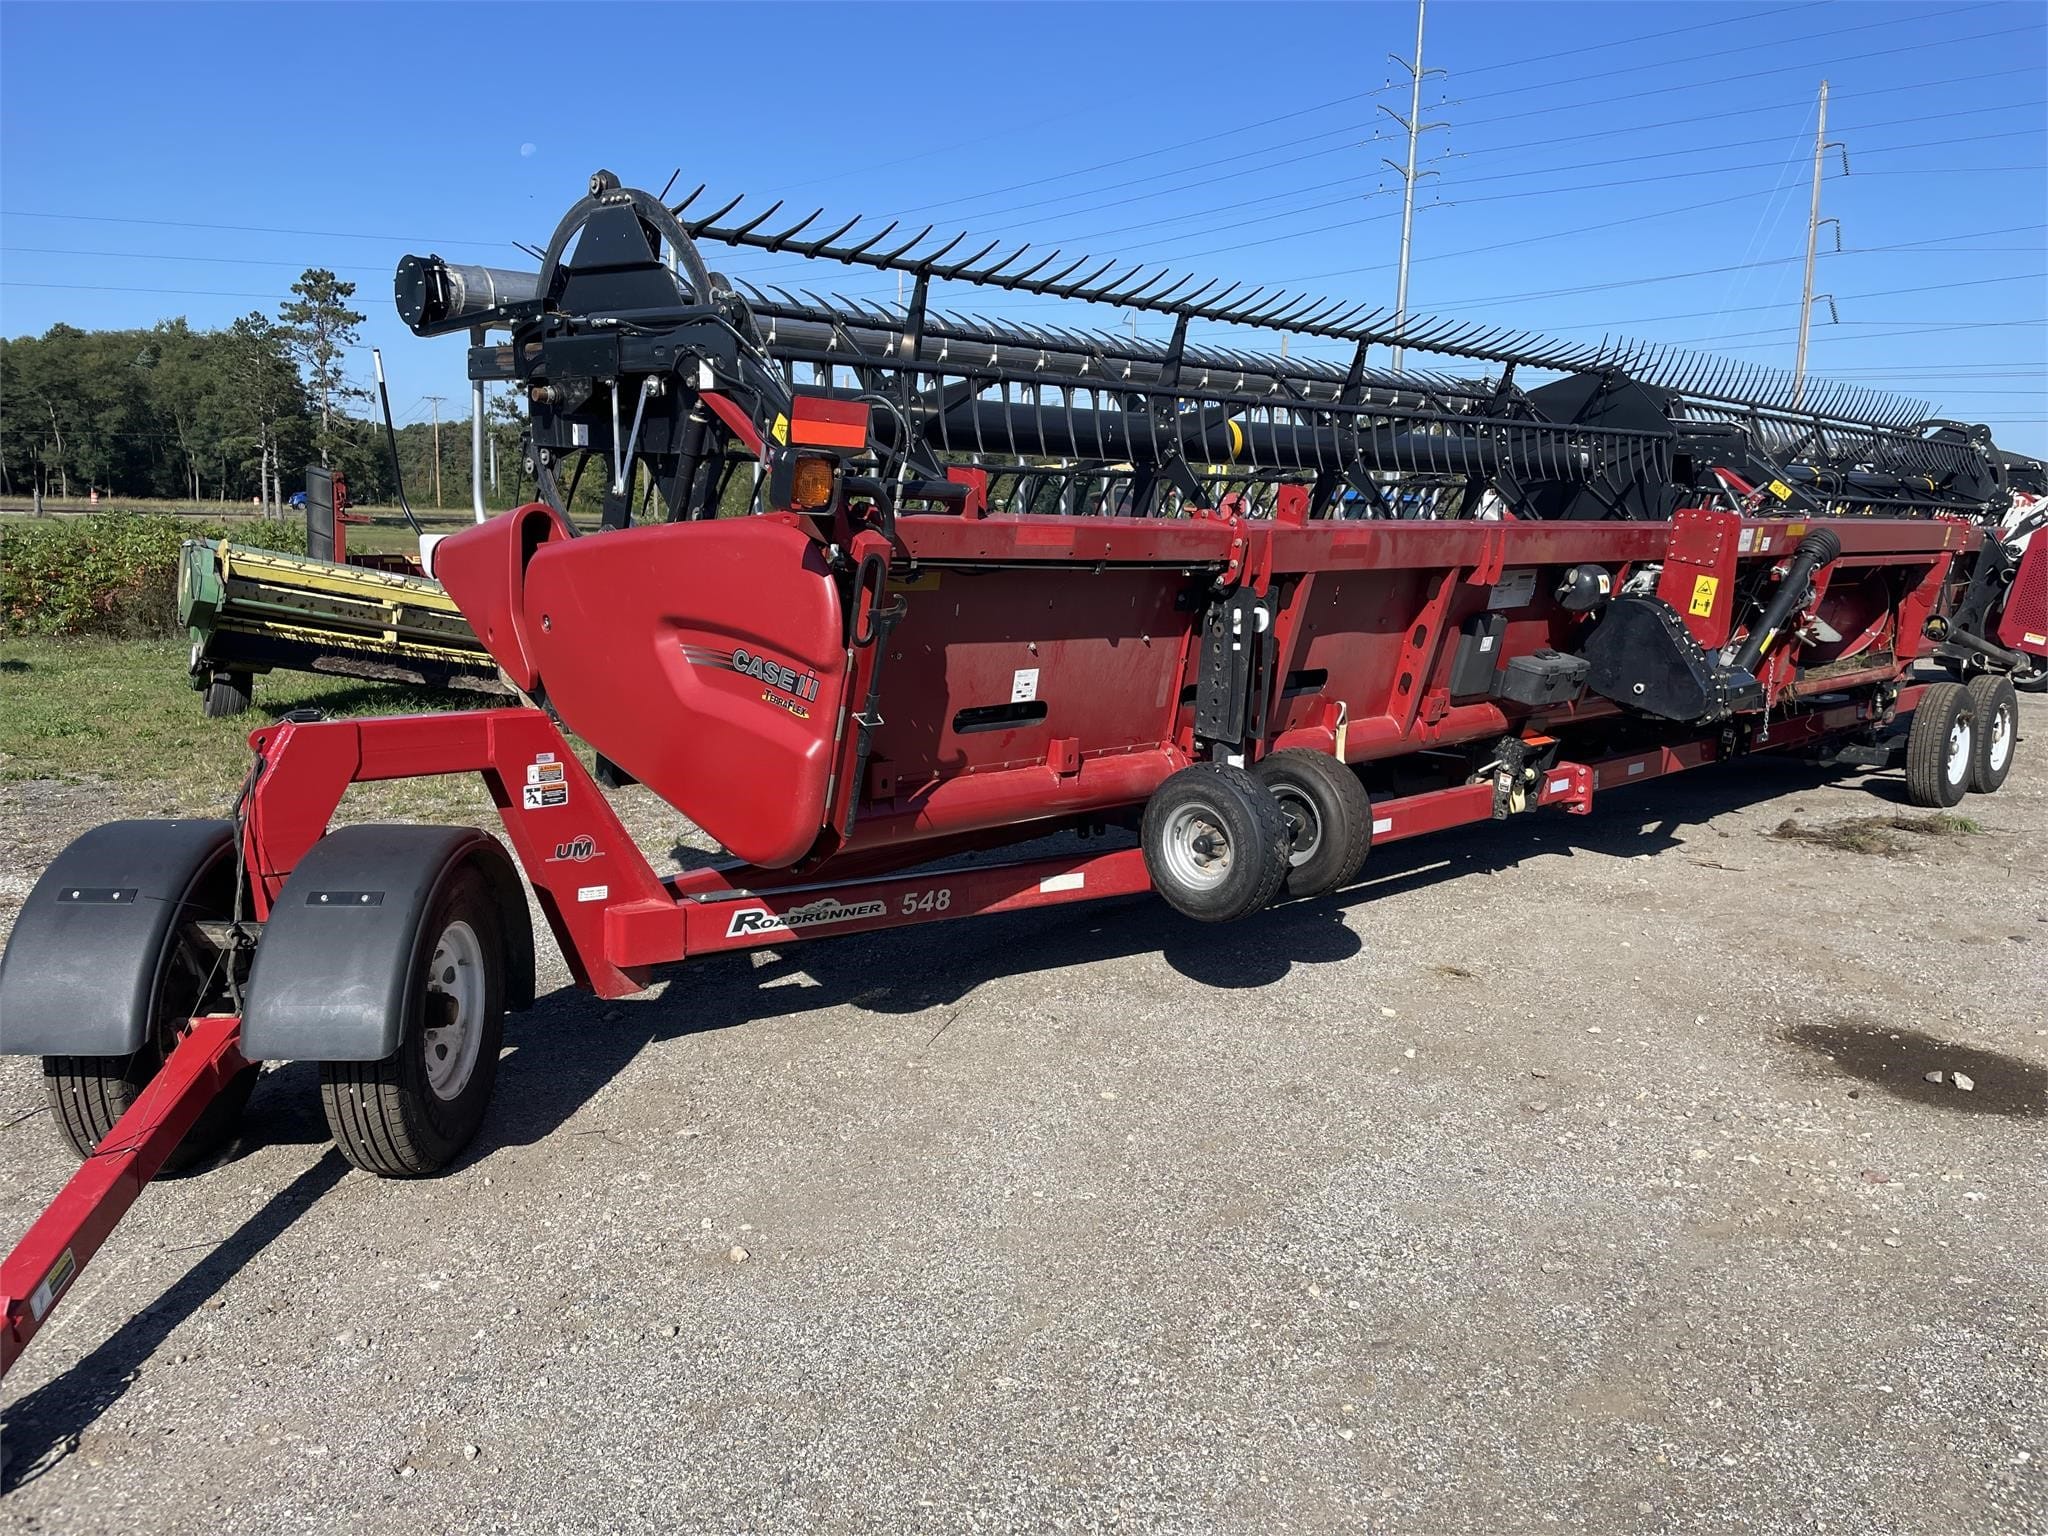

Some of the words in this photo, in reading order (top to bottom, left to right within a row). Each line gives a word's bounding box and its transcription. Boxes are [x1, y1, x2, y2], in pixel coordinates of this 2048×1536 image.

[732, 649, 795, 692] CASE
[556, 841, 592, 859] UM
[732, 902, 882, 934] ROADRUNNER
[901, 888, 951, 915] 548
